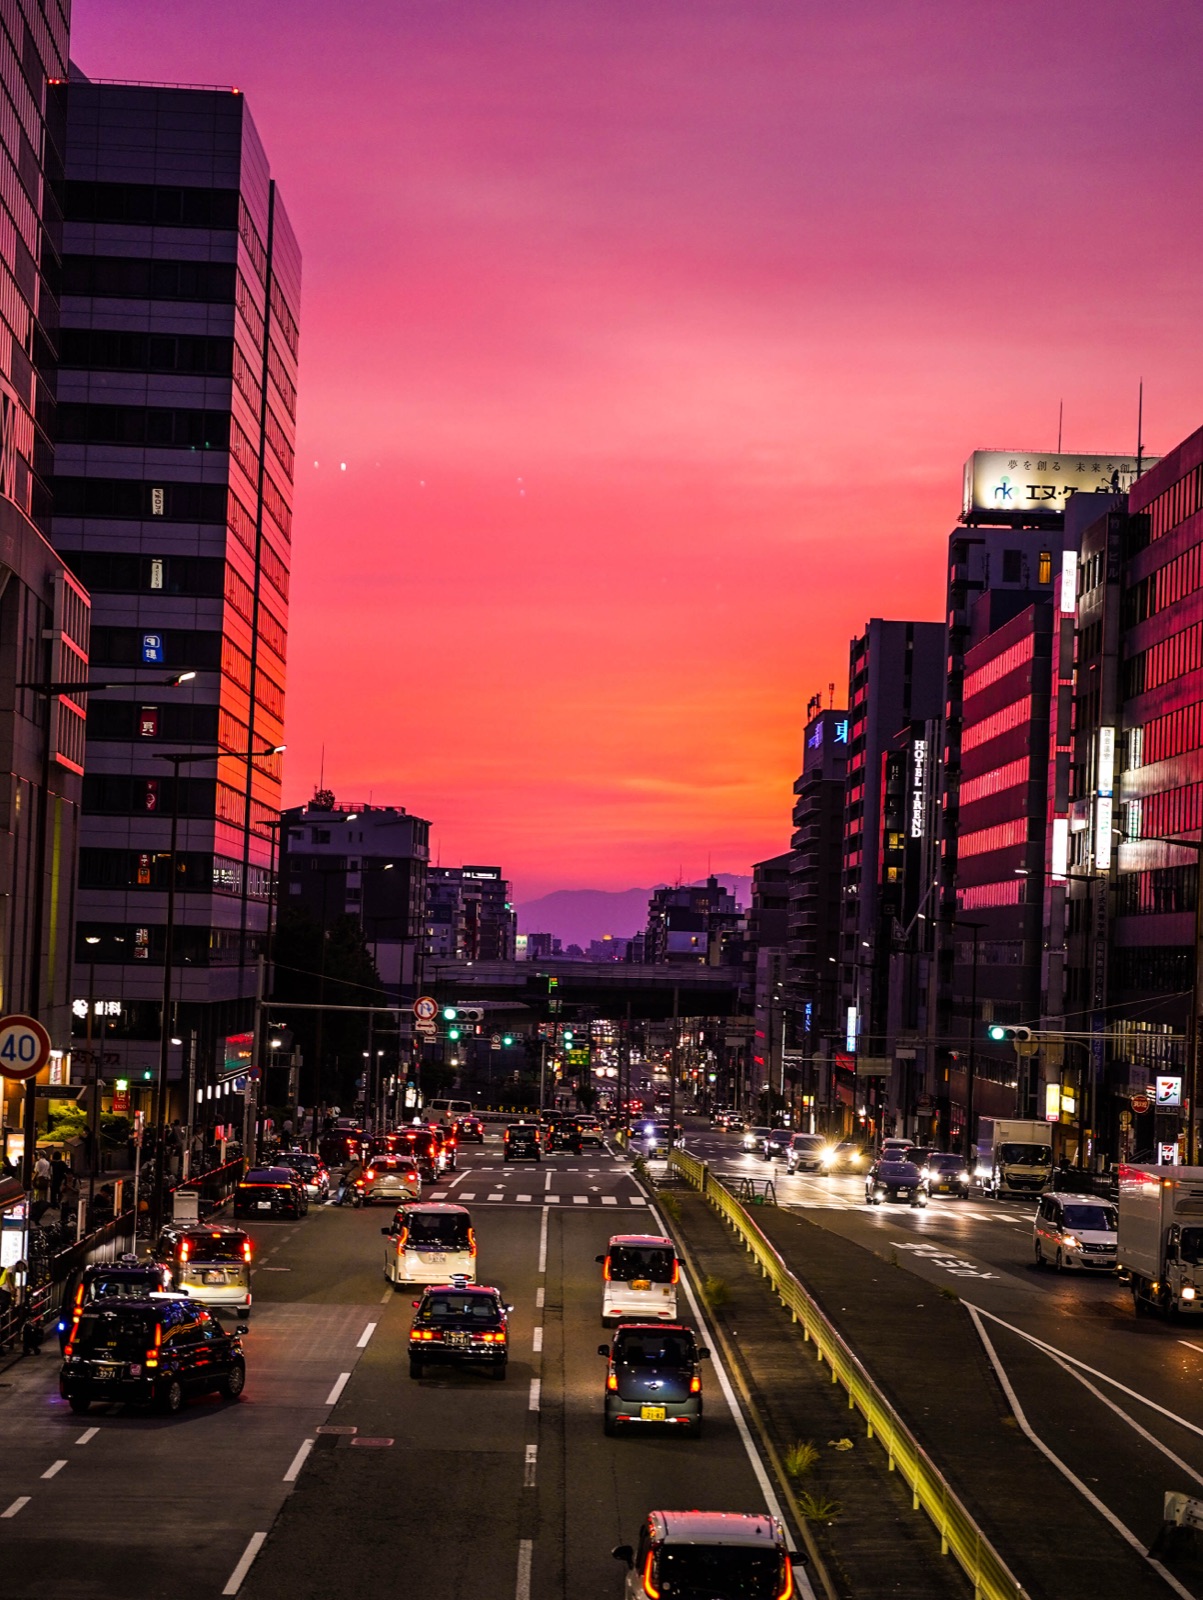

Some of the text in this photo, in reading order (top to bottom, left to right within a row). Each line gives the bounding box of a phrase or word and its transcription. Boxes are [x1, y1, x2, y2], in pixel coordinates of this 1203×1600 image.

[911, 740, 925, 838] HOTEL TREND
[1, 1033, 36, 1061] 40
